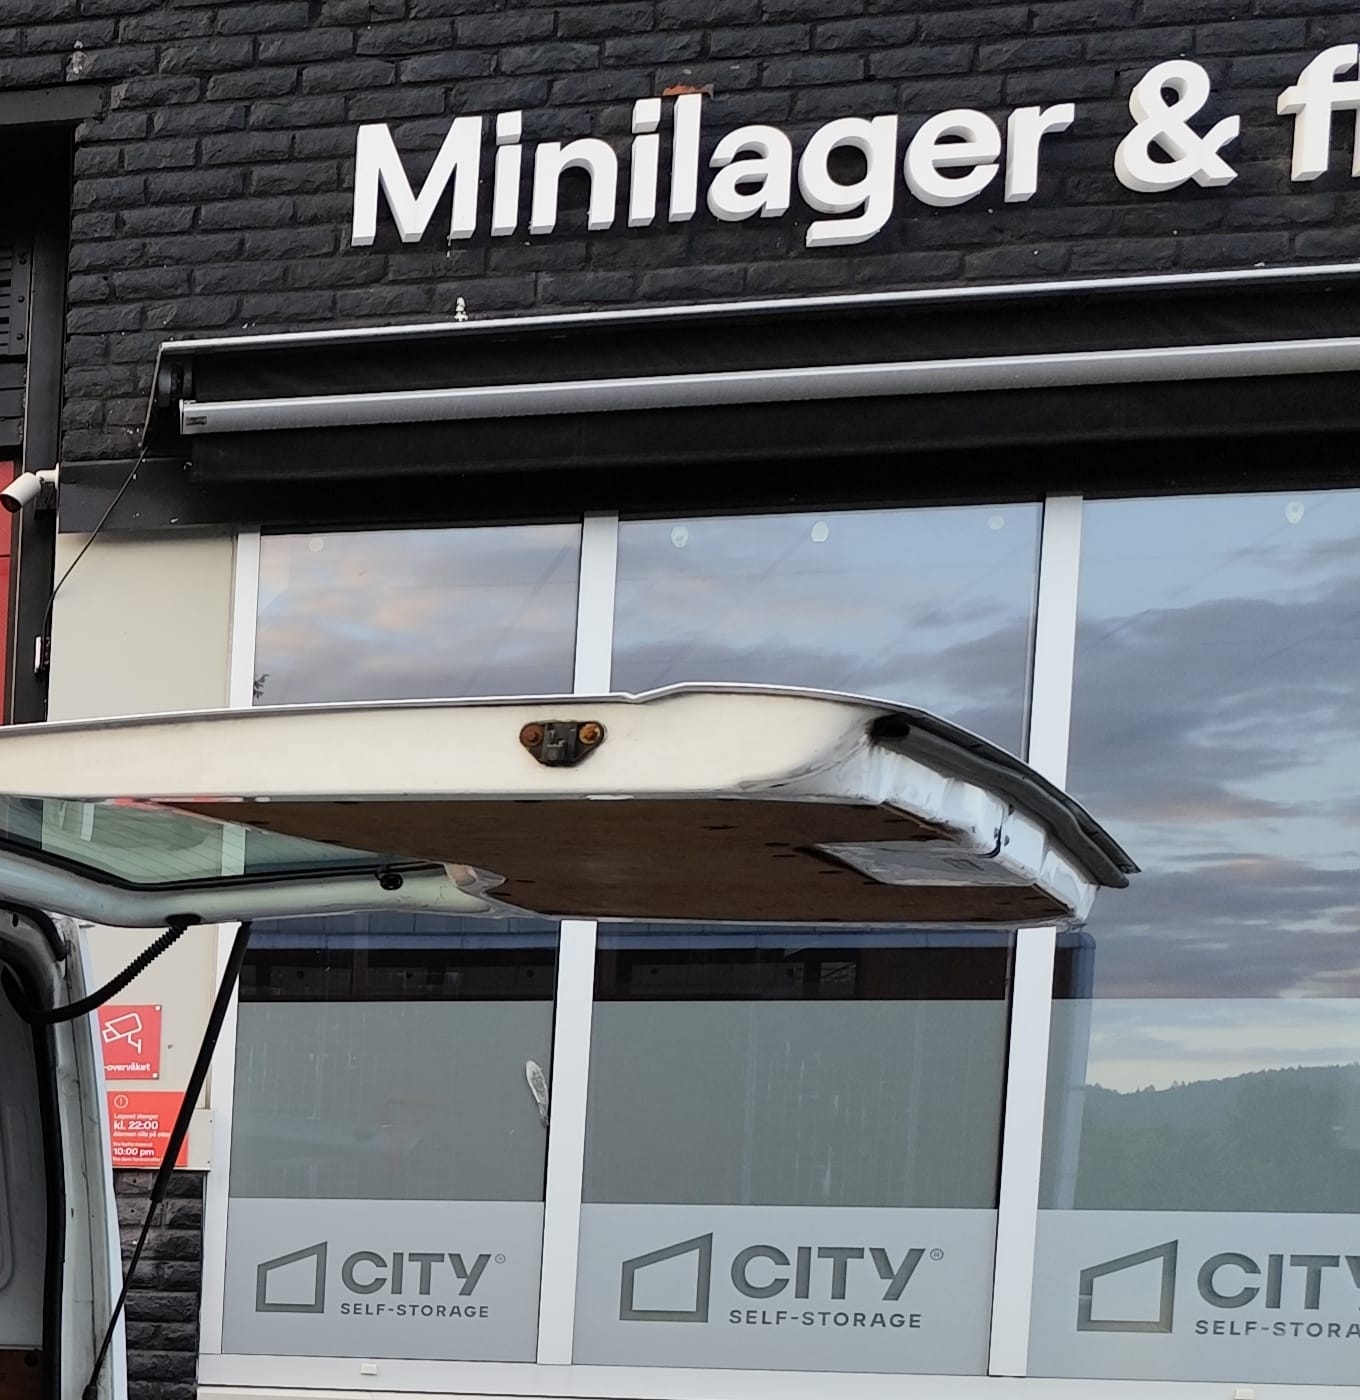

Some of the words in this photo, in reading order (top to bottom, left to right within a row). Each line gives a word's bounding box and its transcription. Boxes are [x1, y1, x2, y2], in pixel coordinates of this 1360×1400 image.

[351, 90, 1077, 247] Minilager
[1114, 59, 1240, 193] &
[1197, 1252, 1360, 1310] CIT
[340, 1303, 489, 1319] SELF-STORAGE
[729, 1309, 922, 1329] SELF-STORAGE
